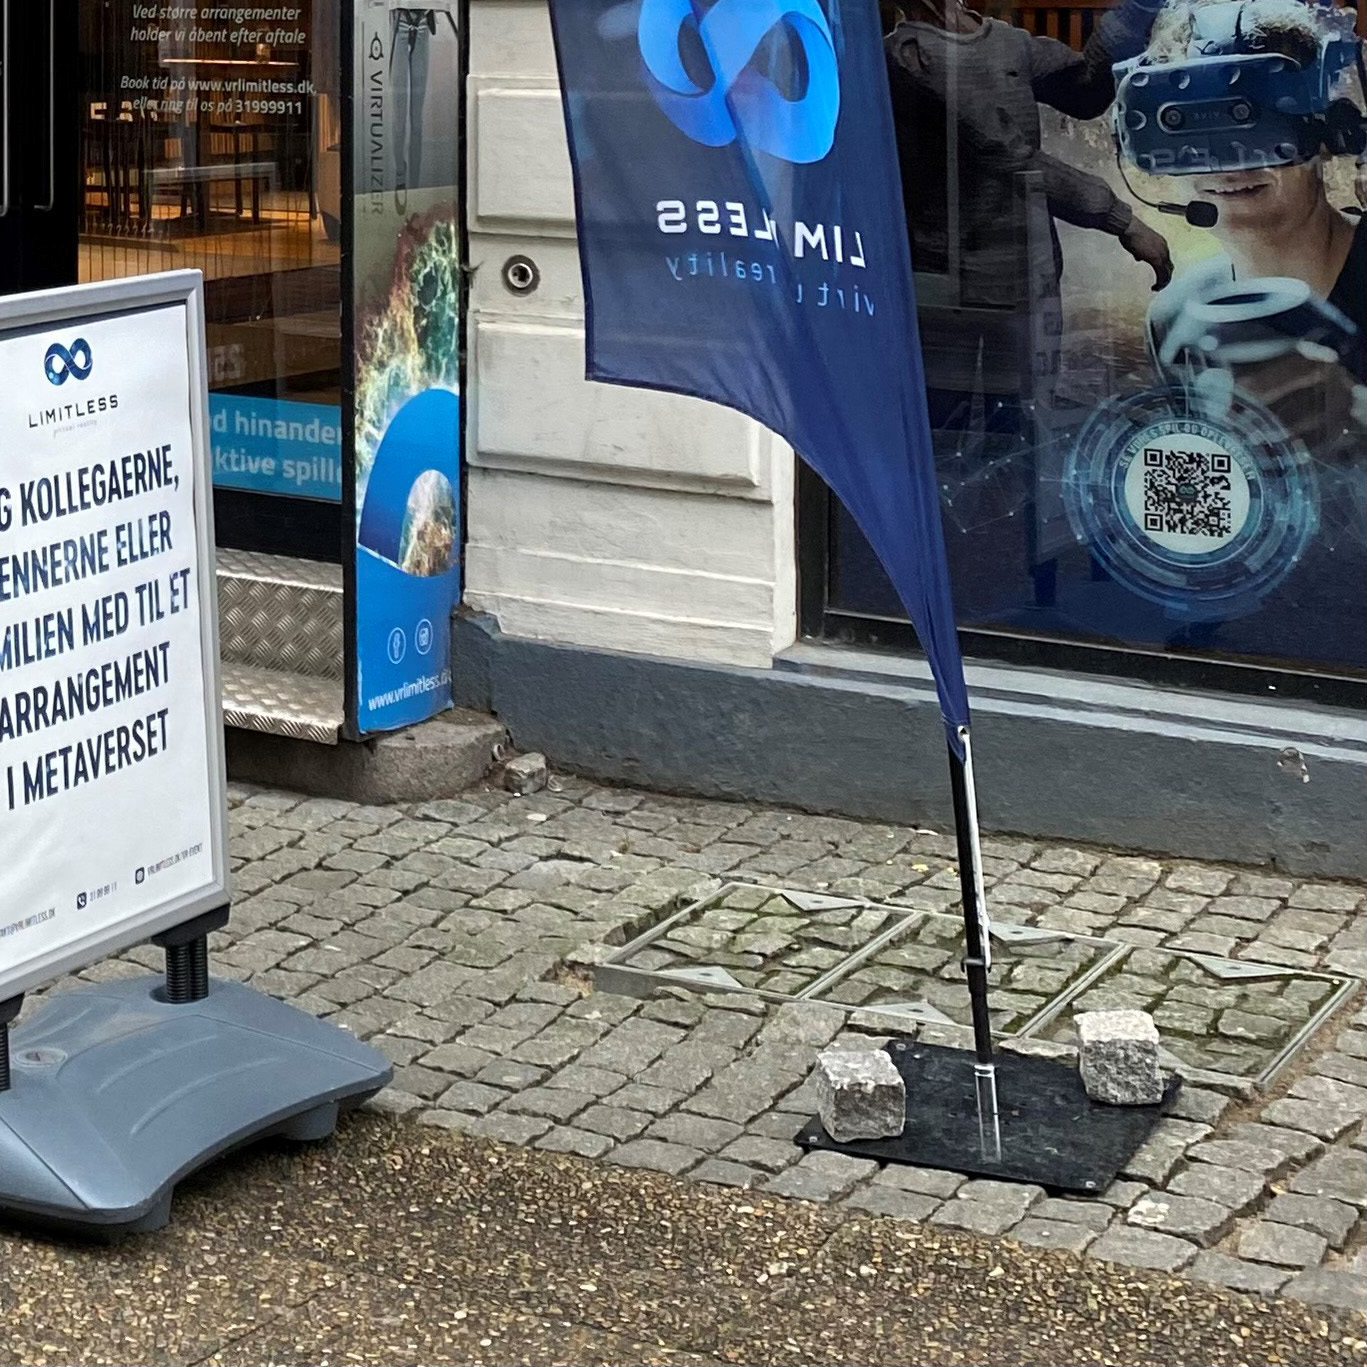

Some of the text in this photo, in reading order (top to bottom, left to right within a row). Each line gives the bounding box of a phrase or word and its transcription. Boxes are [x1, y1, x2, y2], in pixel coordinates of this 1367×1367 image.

[132, 4, 301, 23] Ved større arrangementer
[130, 24, 306, 47] holder vi åbent efter aftale
[120, 76, 149, 90] Book
[152, 76, 168, 90] tid
[169, 77, 186, 93] på
[200, 100, 214, 111] os
[217, 98, 233, 115] på
[235, 99, 302, 115] 31999911
[28, 394, 118, 428] LIMITLESS
[212, 445, 276, 476] ktive
[20, 444, 179, 527] KOLLEGAERNE,
[115, 510, 173, 568] ELLER
[81, 592, 129, 646] MED
[135, 578, 165, 626] TIL
[169, 567, 191, 614] ET
[7, 707, 169, 811] I METAVERSET
